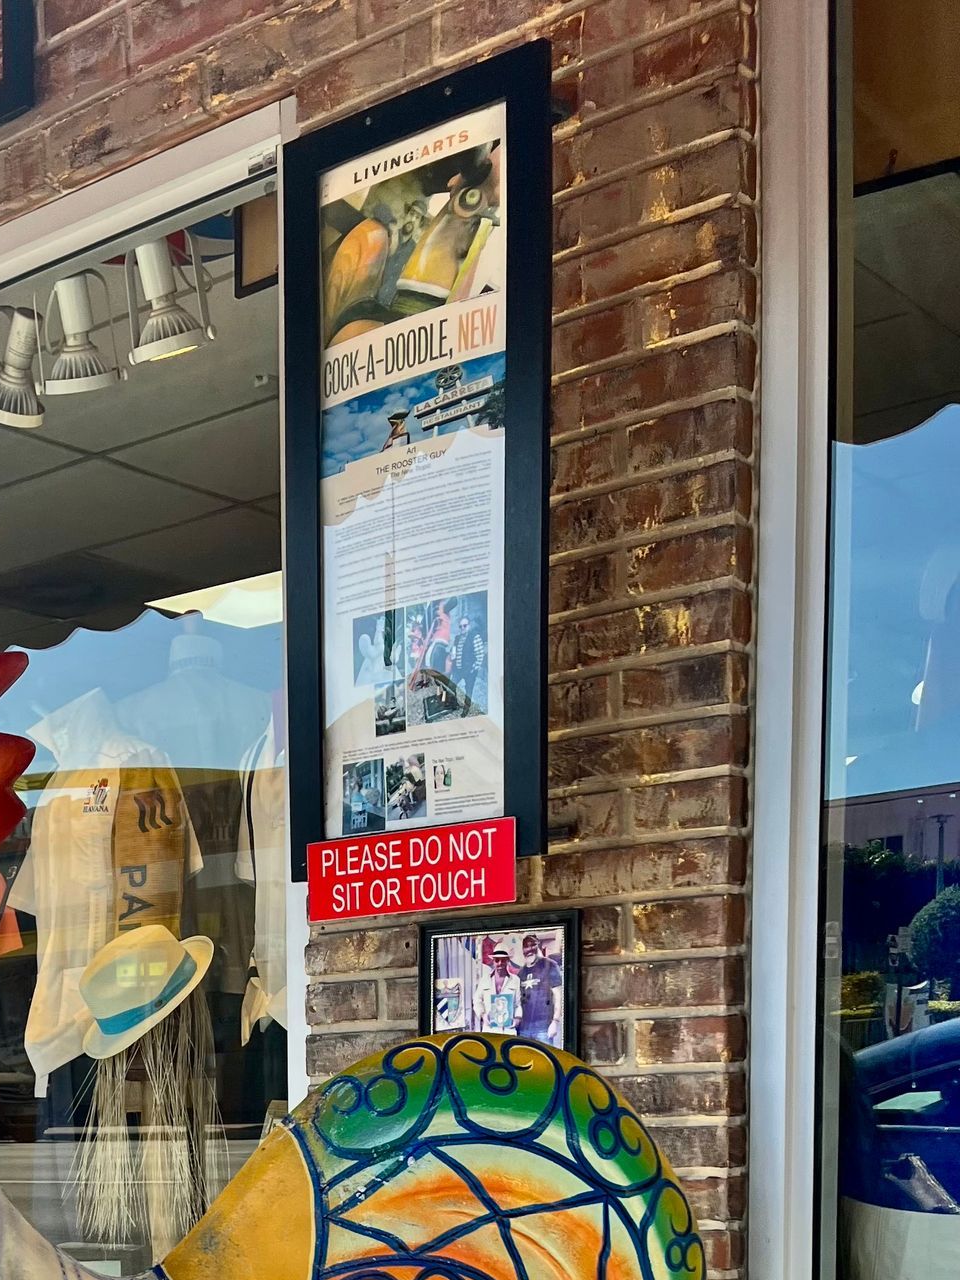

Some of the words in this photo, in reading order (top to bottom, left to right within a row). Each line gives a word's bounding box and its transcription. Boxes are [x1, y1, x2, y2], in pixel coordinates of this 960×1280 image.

[323, 318, 453, 398] COCK-A-DOODLE,
[457, 304, 498, 353] NEW
[416, 402, 431, 413] LA
[375, 465, 390, 475] THE
[391, 453, 428, 470] ROOSTER
[429, 448, 447, 460] GUY
[322, 840, 403, 878] PLEASE
[409, 835, 441, 867] DO
[449, 828, 497, 862] NOT
[332, 881, 364, 913] SIT
[369, 878, 402, 909] OR
[406, 868, 486, 904] TOUCH
